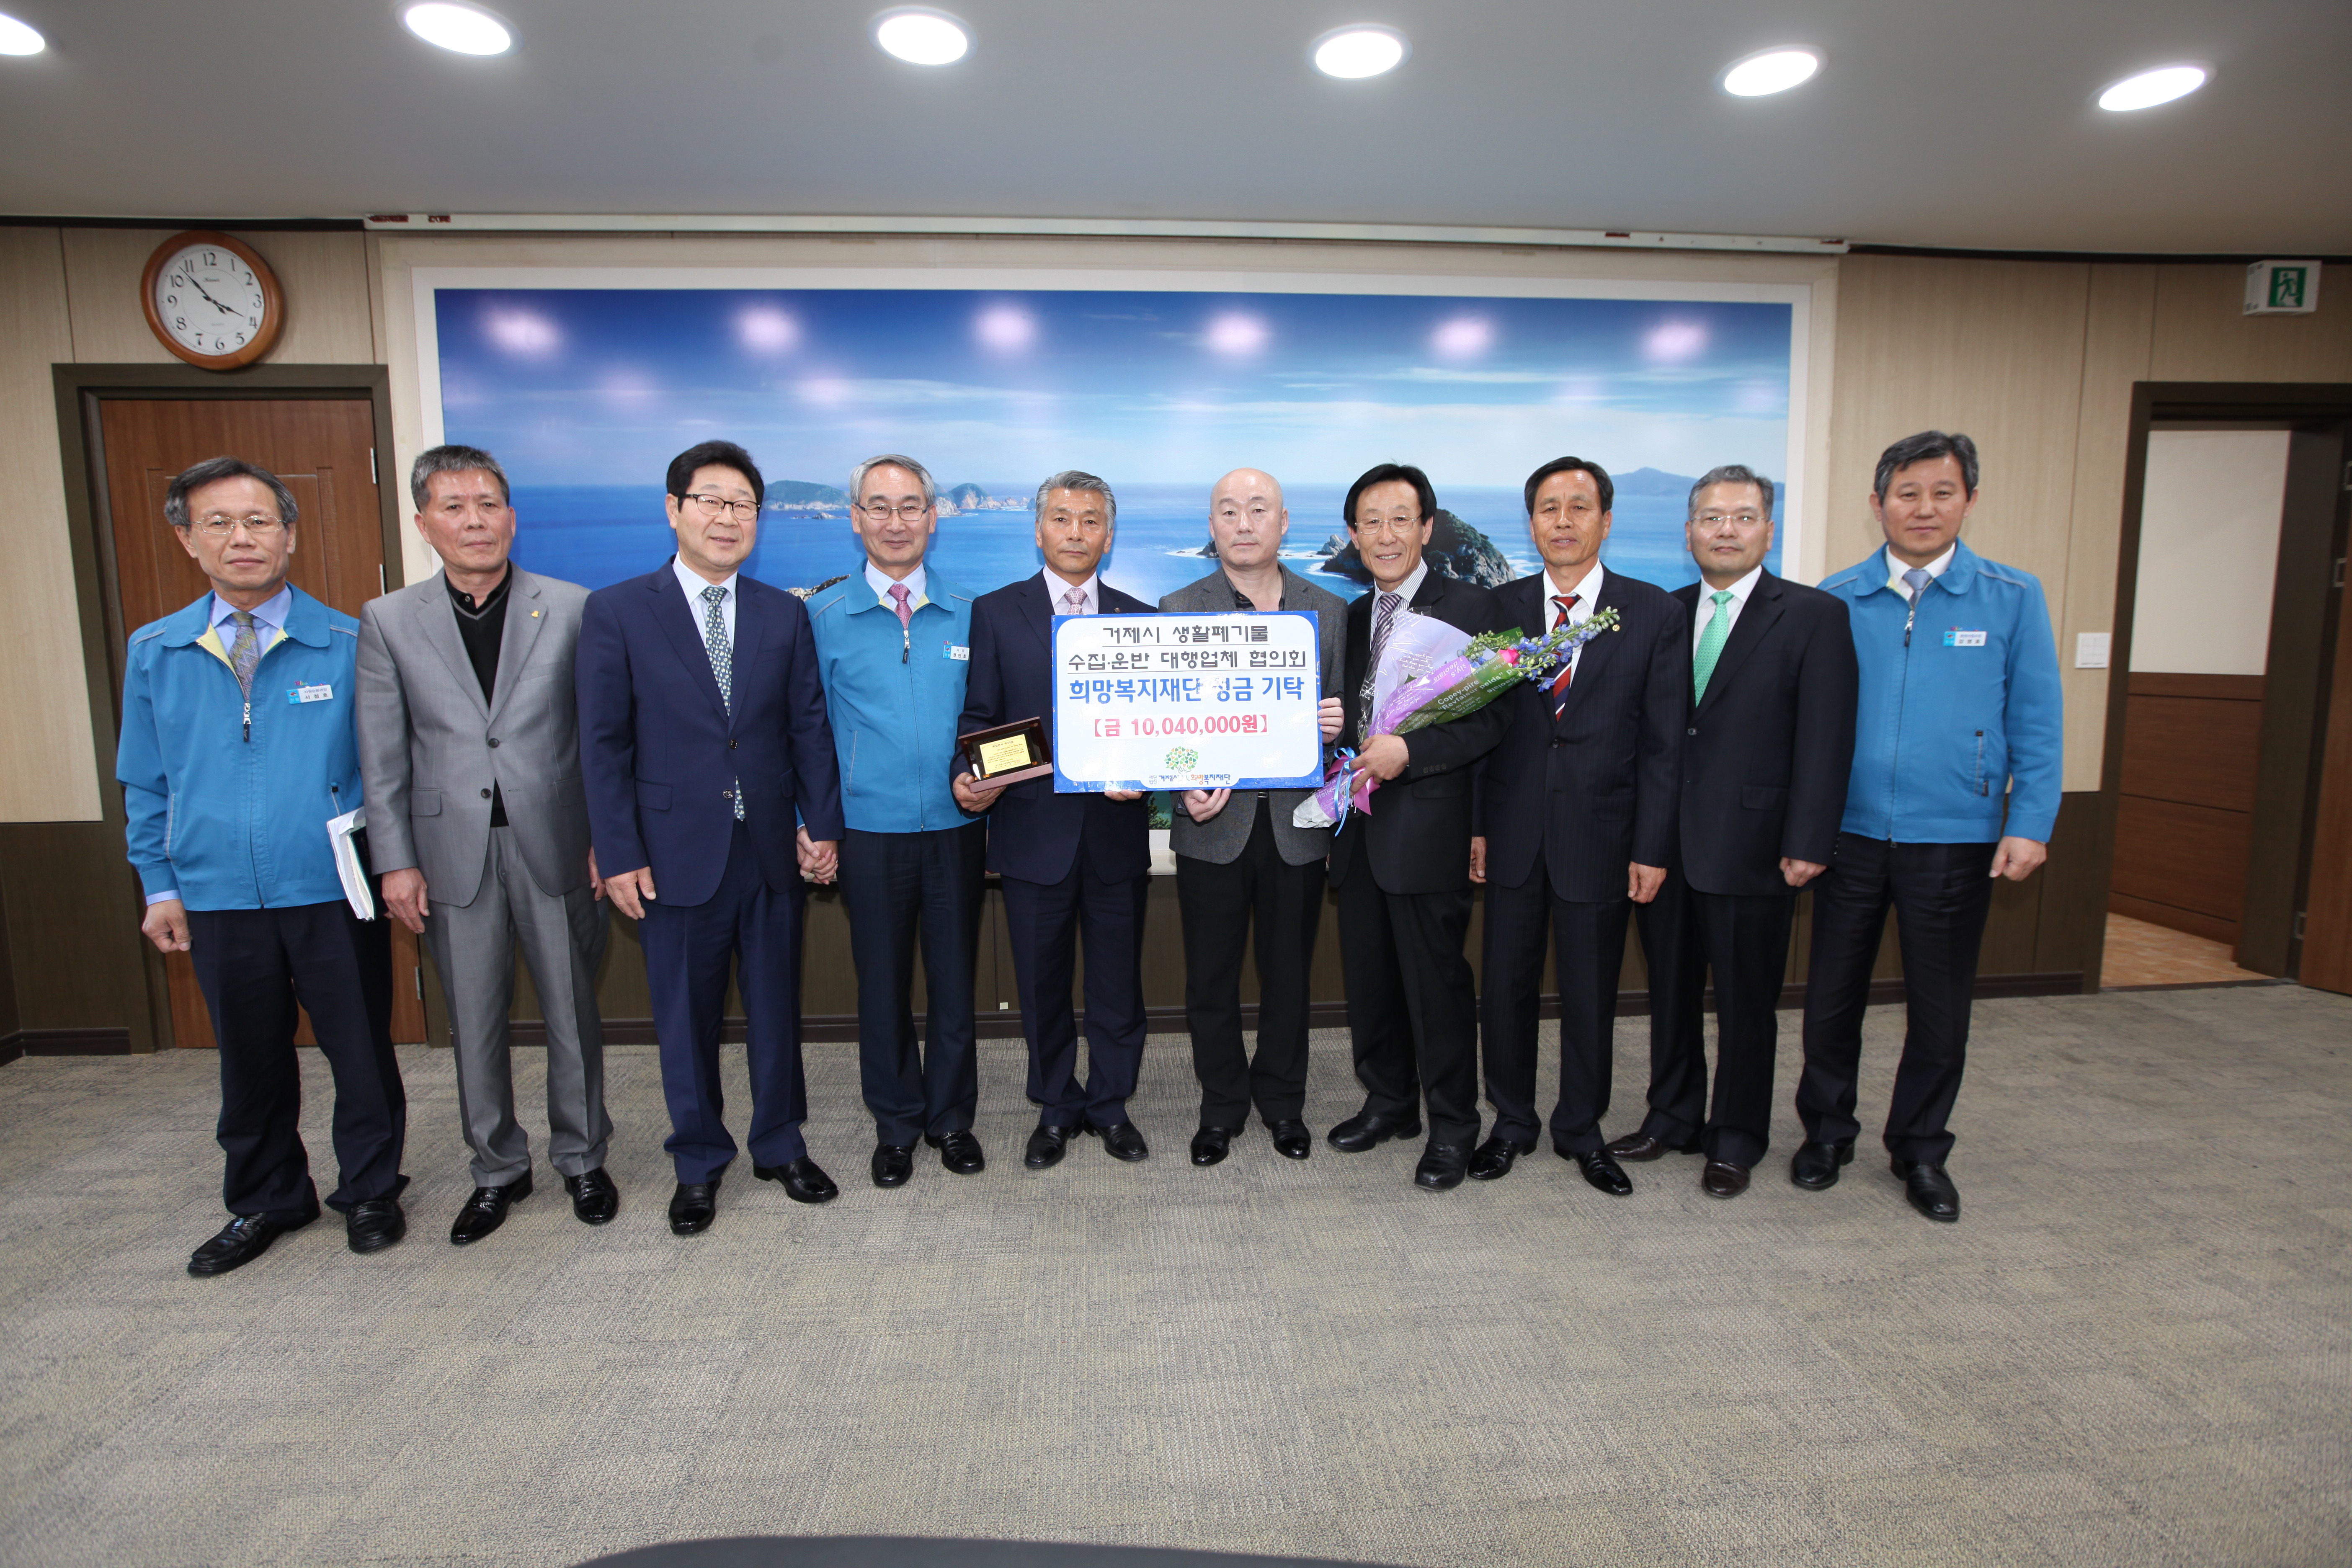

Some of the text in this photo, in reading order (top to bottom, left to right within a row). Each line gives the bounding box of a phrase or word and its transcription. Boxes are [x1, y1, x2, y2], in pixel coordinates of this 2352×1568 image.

[184, 259, 194, 273] 11
[203, 252, 217, 266] 12
[230, 258, 236, 271] 1
[170, 275, 184, 288] 10
[244, 272, 253, 286] 2
[167, 295, 178, 309] 9
[253, 294, 262, 308] 3
[176, 317, 187, 330] 8
[249, 316, 258, 329] 4
[195, 333, 204, 346] 7
[215, 337, 225, 351] 6
[236, 332, 245, 345] 5
[1103, 625, 1268, 644] 거제시 생활폐기물
[1068, 650, 1306, 671] 수집·운반 대행업체 협의회
[1069, 678, 1204, 704] 희망복지재단
[1262, 676, 1305, 701] 기탁
[1437, 680, 1479, 705] Copey-pire
[1190, 774, 1231, 785] 희망복지재단
